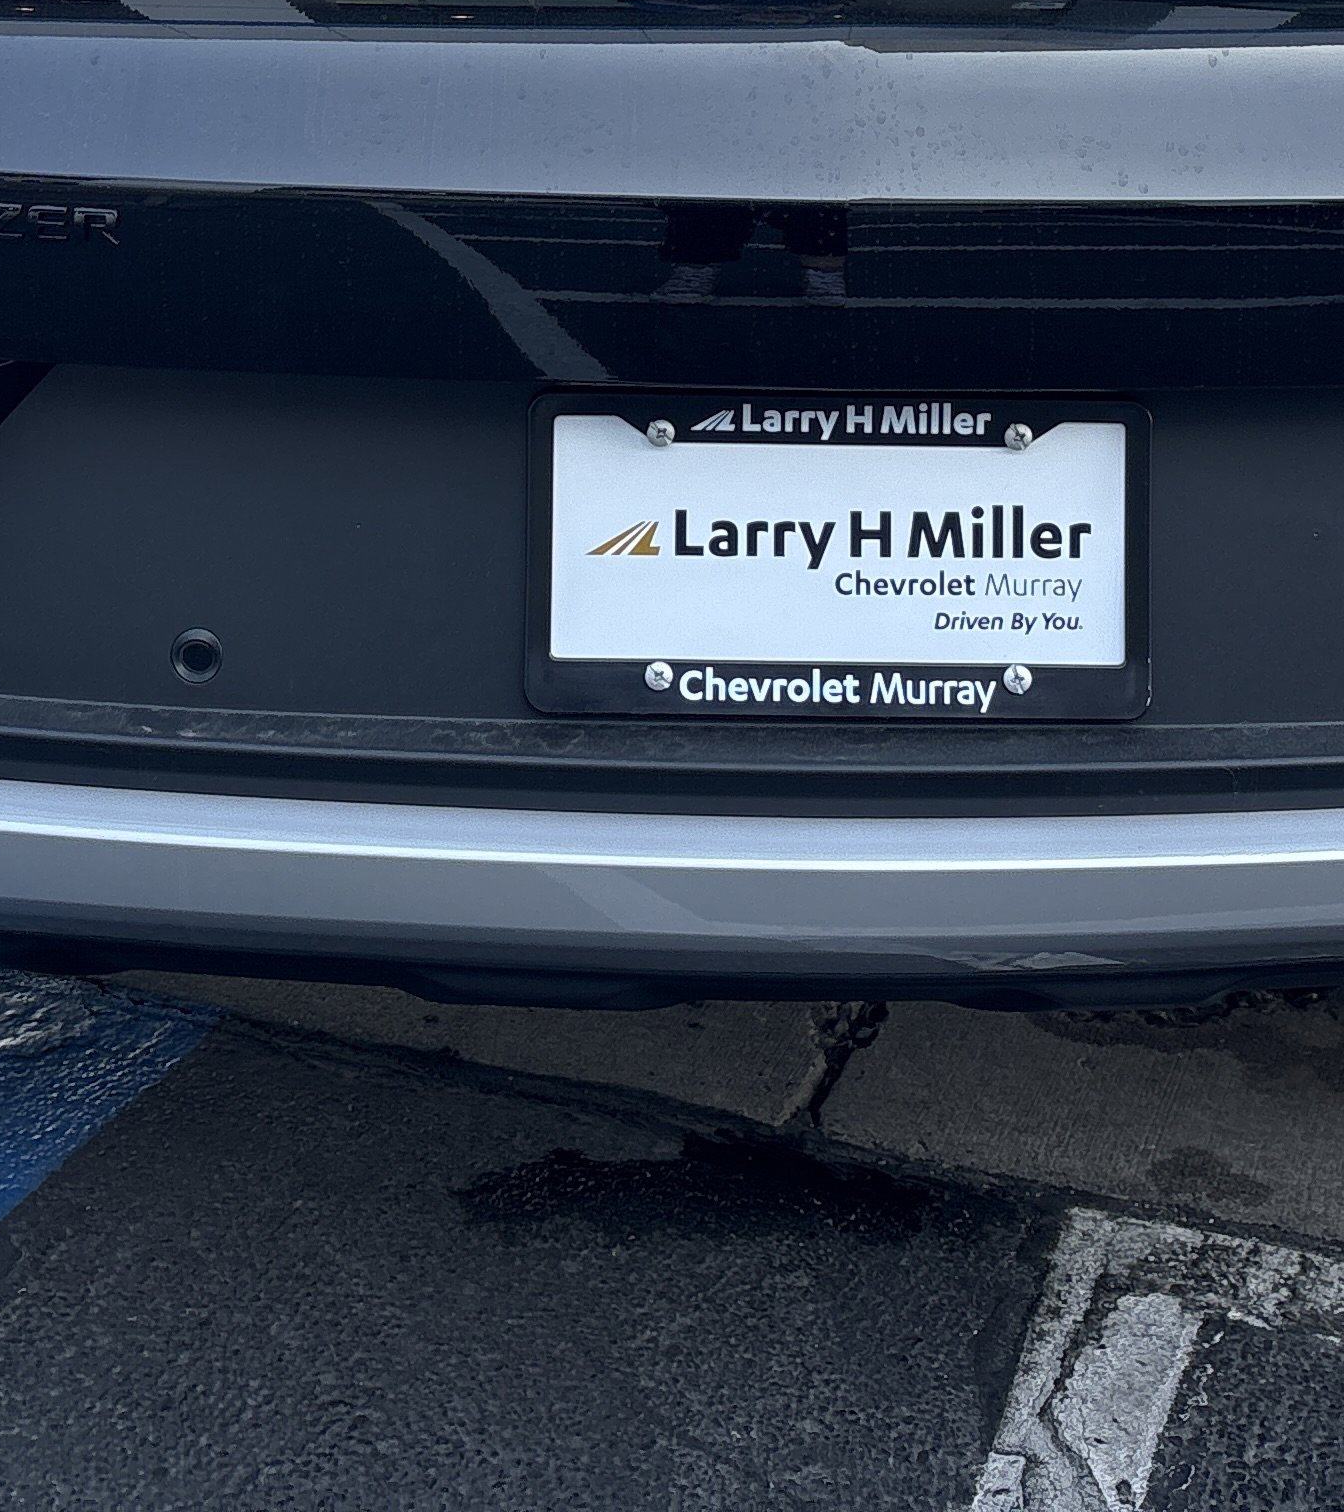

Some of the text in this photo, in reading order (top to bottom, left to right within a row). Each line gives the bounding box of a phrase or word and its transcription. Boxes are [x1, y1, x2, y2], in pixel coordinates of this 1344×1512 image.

[741, 403, 992, 441] Larry H Miller
[674, 505, 1092, 570] Larry H Miller
[834, 570, 1084, 602] Chevrolet Murray
[933, 611, 1085, 635] Driven By You.
[678, 667, 998, 714] Chevrolet Murray
